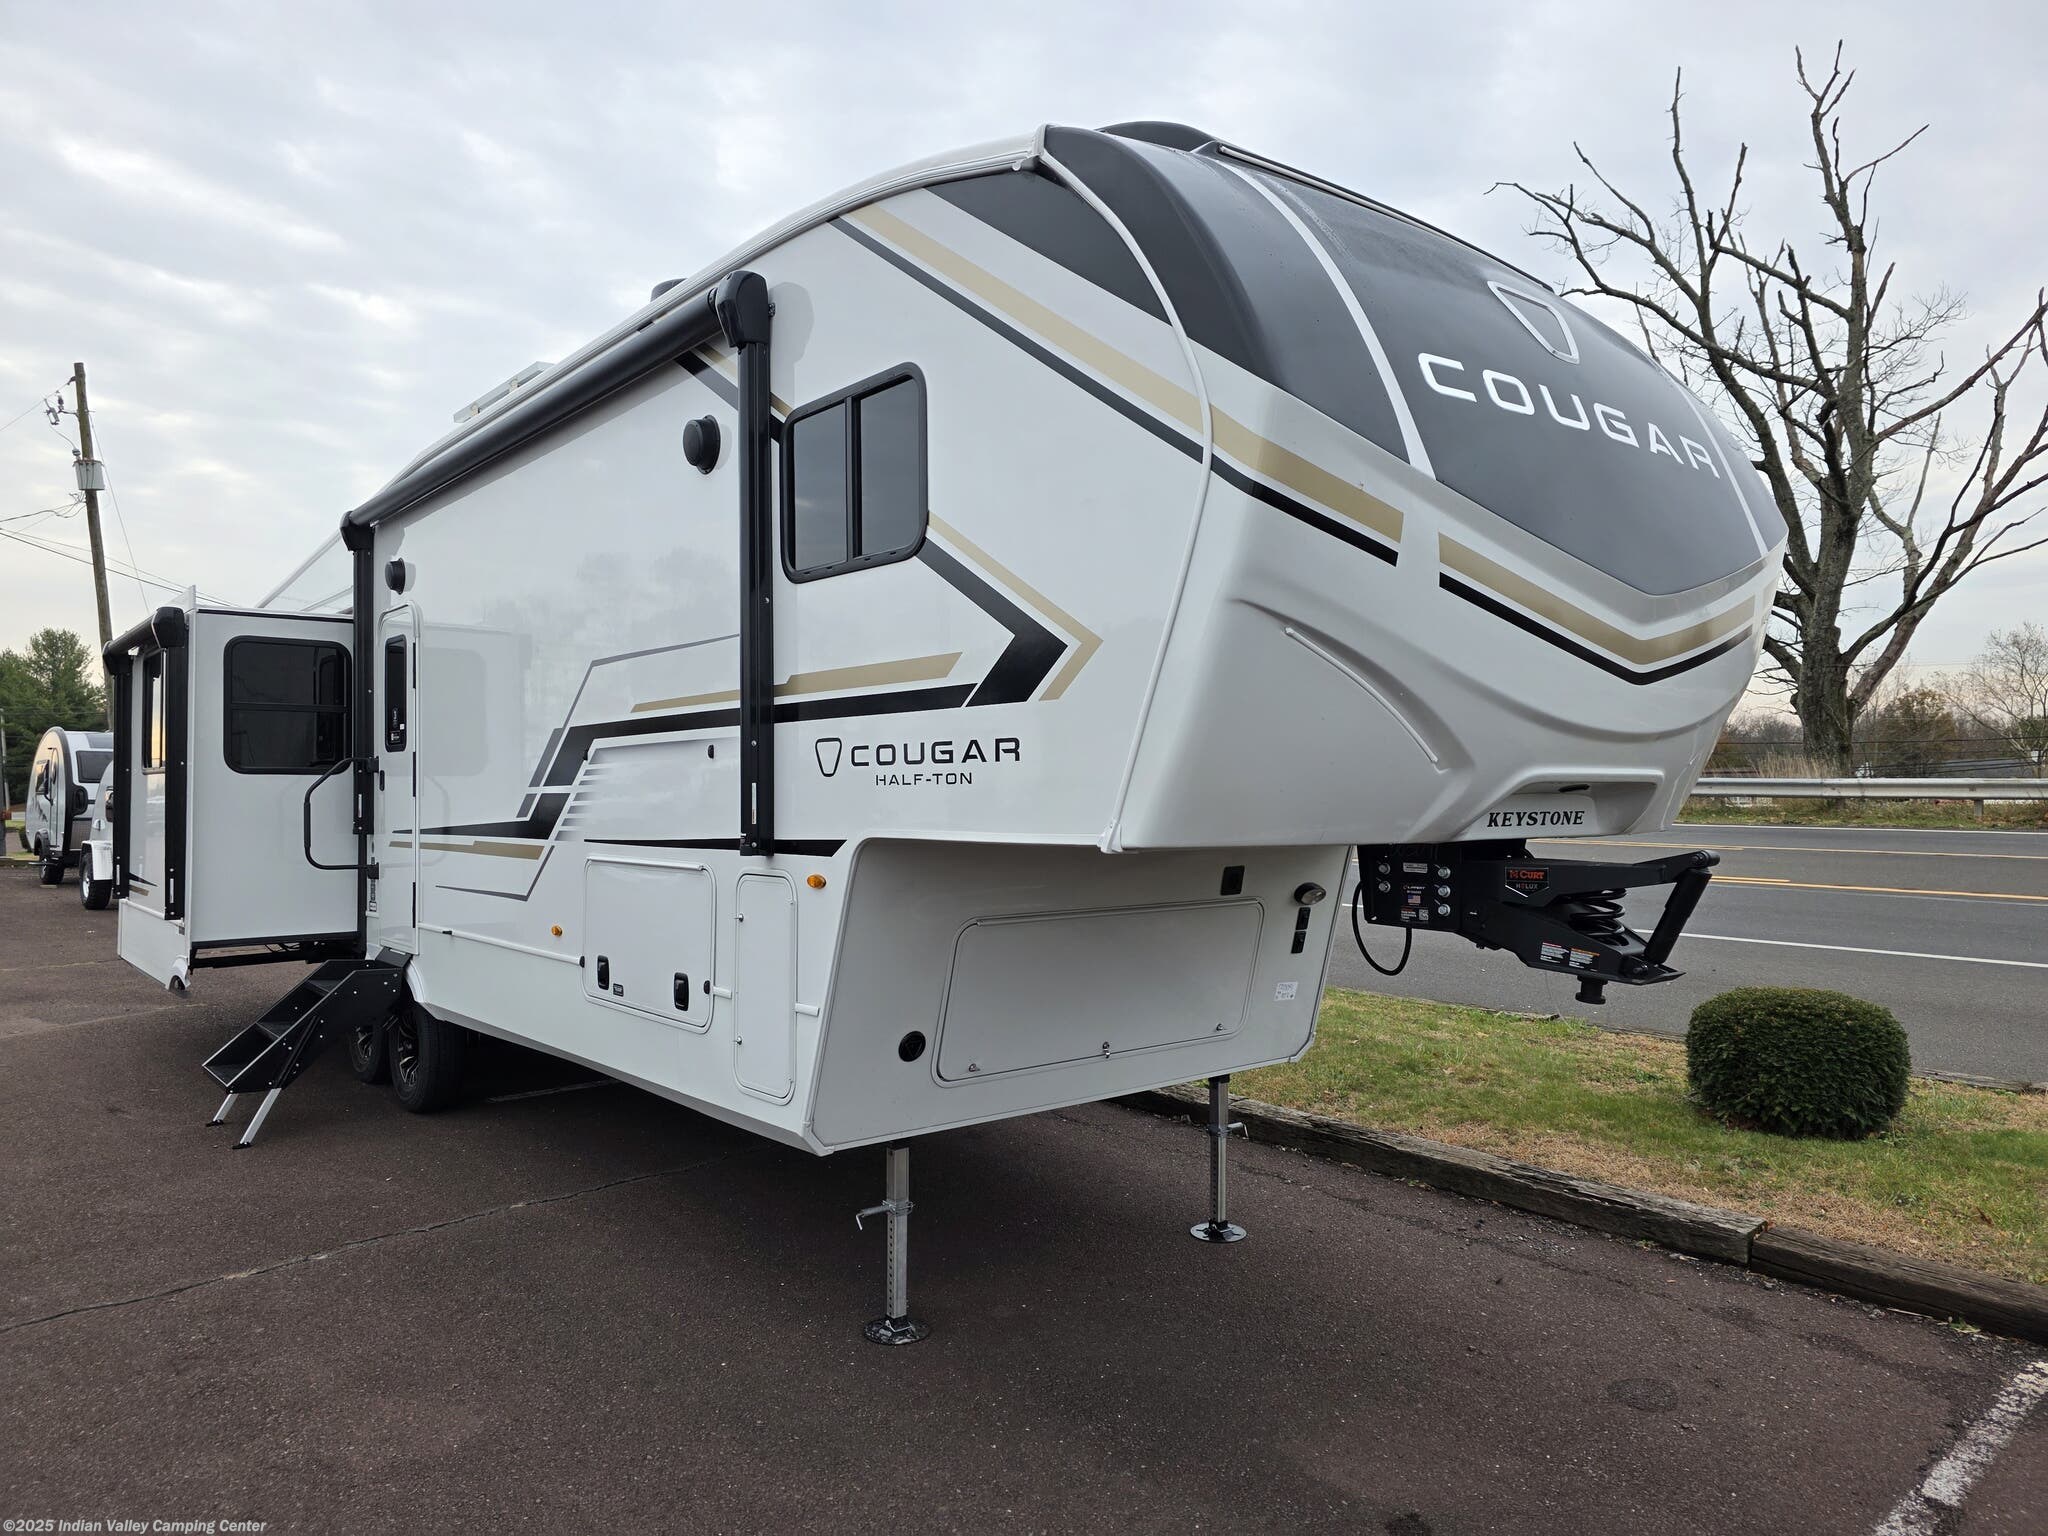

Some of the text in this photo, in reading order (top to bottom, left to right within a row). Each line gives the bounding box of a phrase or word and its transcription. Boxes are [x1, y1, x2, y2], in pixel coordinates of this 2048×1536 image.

[1418, 352, 1720, 479] COUGAR
[851, 737, 1021, 767] COUGAR
[875, 772, 973, 786] HALF-TON
[1487, 811, 1585, 828] KEYSTONE
